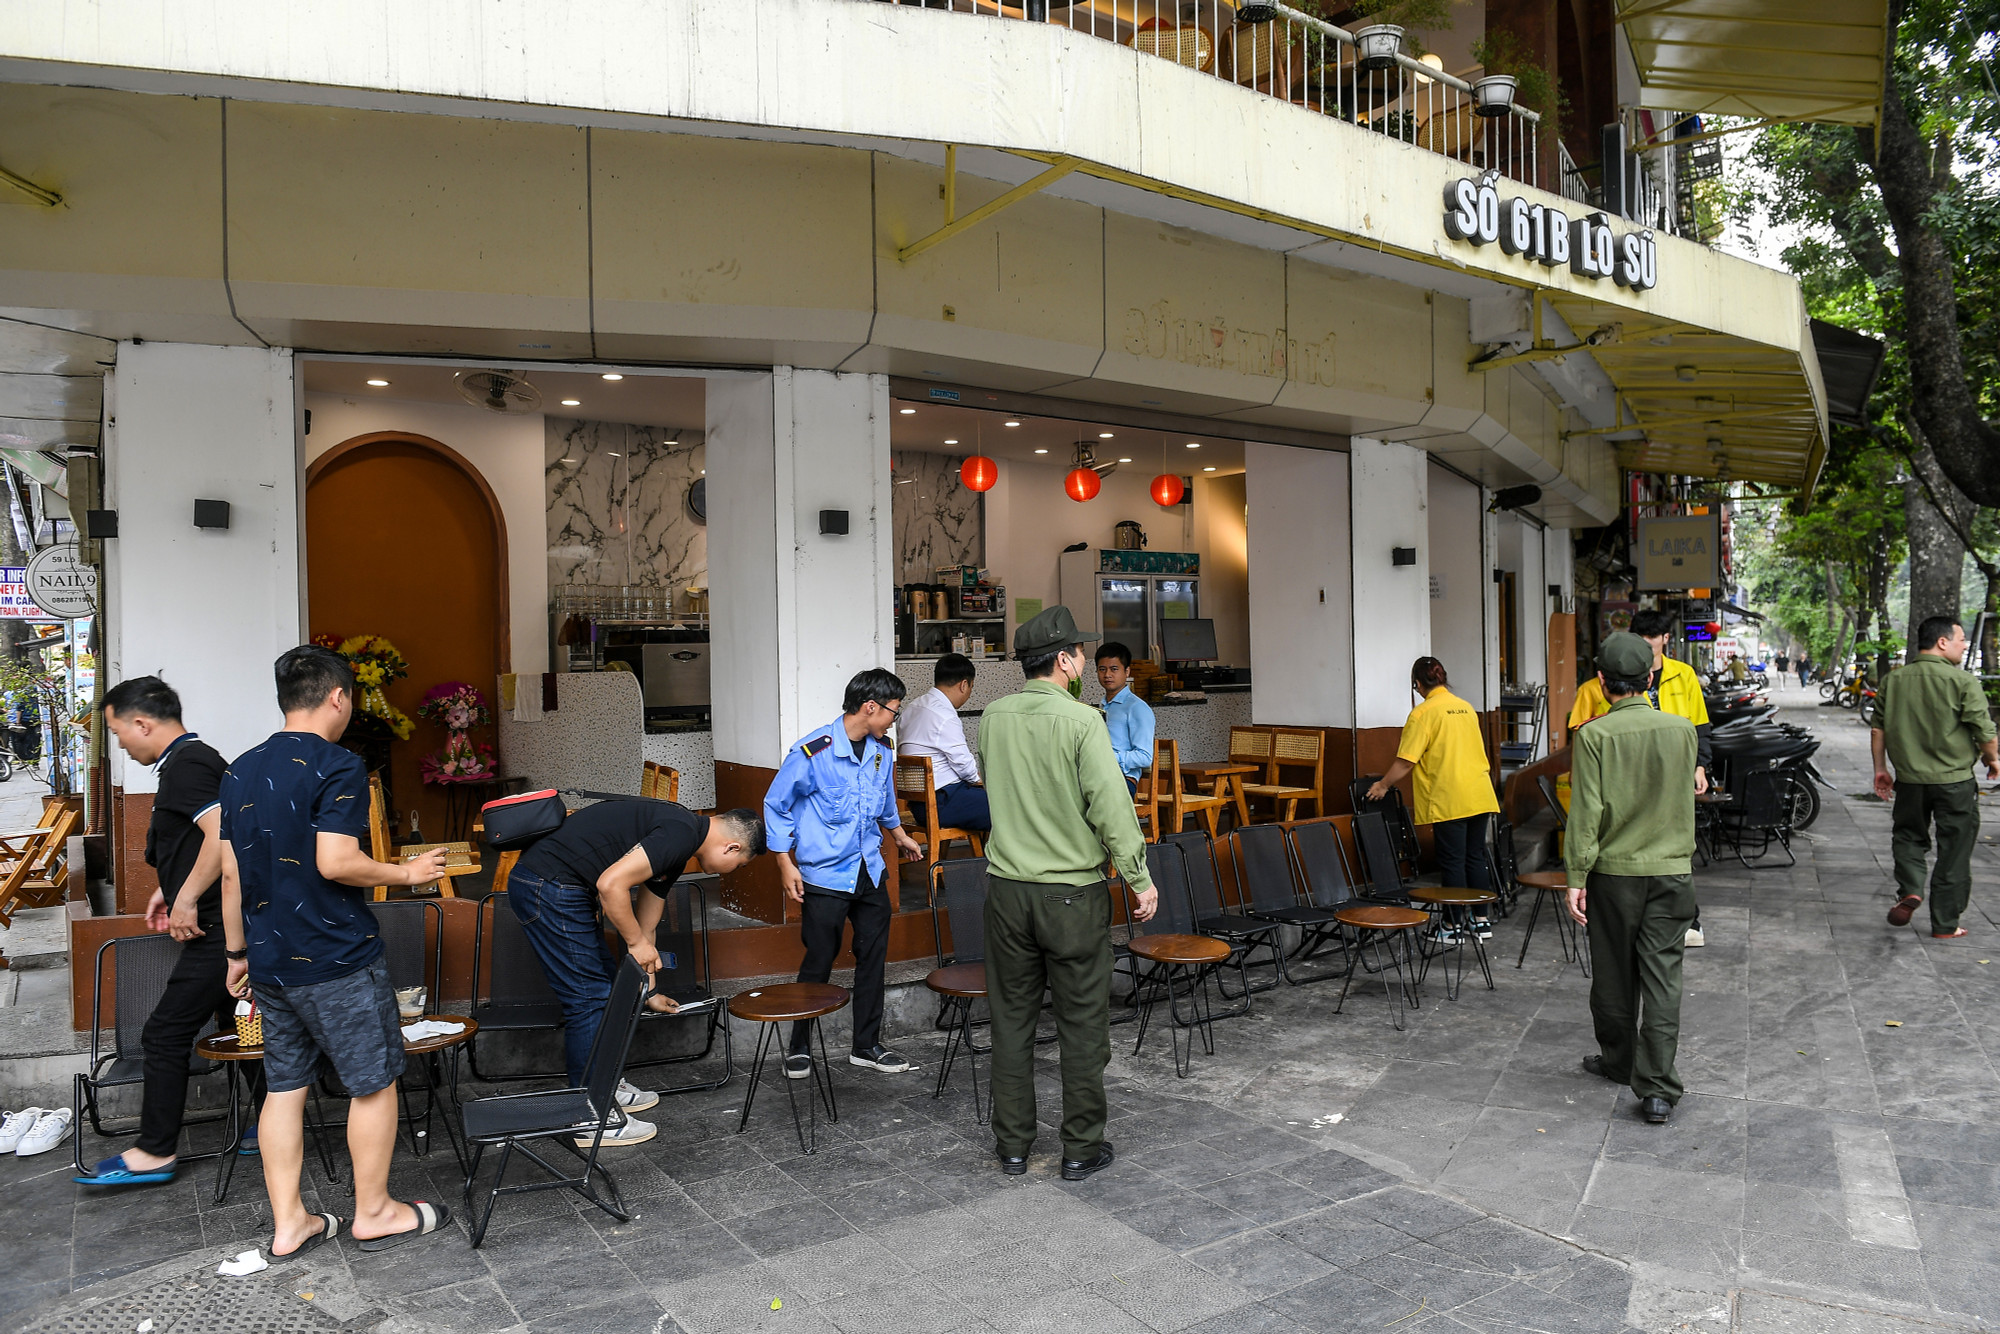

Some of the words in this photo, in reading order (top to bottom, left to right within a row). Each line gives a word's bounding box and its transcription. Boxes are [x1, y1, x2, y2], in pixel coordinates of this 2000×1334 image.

[1451, 169, 1500, 246] SỐ
[1508, 196, 1570, 266] 61B
[1578, 212, 1615, 279] LÒ
[1621, 229, 1658, 292] SŨ
[1649, 536, 1706, 556] LAIKA
